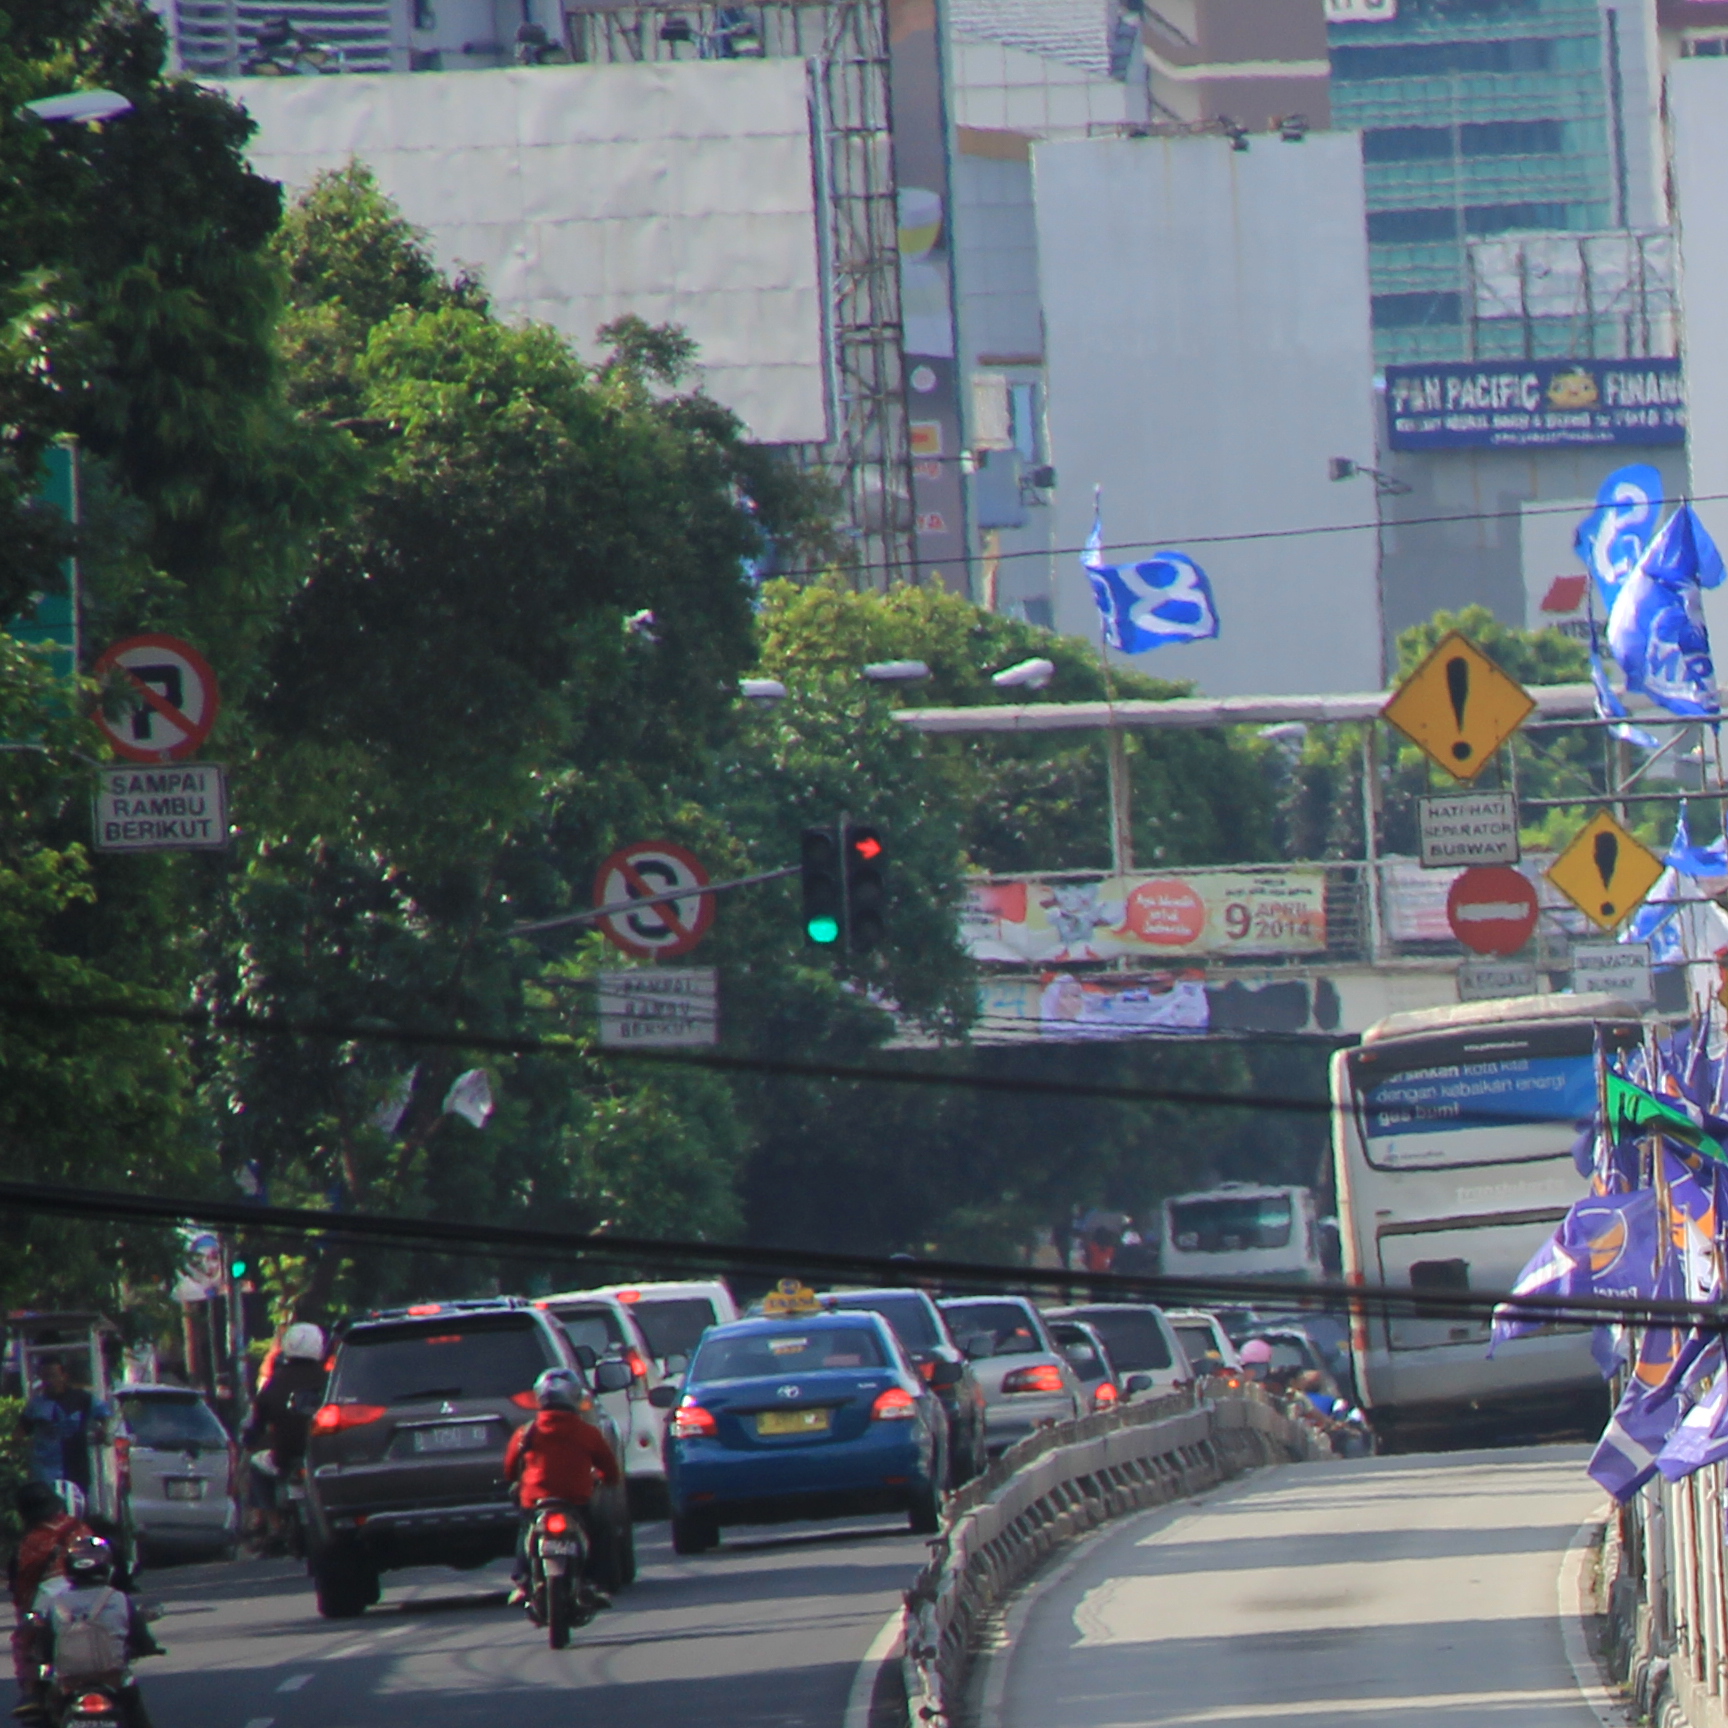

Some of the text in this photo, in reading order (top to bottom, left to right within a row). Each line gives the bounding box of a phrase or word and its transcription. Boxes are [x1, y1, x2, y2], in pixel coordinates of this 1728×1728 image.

[1446, 371, 1541, 412] PACIFIC
[112, 773, 206, 795] SAMPAI
[113, 797, 206, 817] RAMBU
[105, 820, 213, 842] BERIKUT
[1424, 822, 1514, 837] SEPARATOR
[1430, 842, 1508, 858] BUSWAY
[1226, 902, 1251, 940] 9
[1257, 919, 1312, 941] 2014
